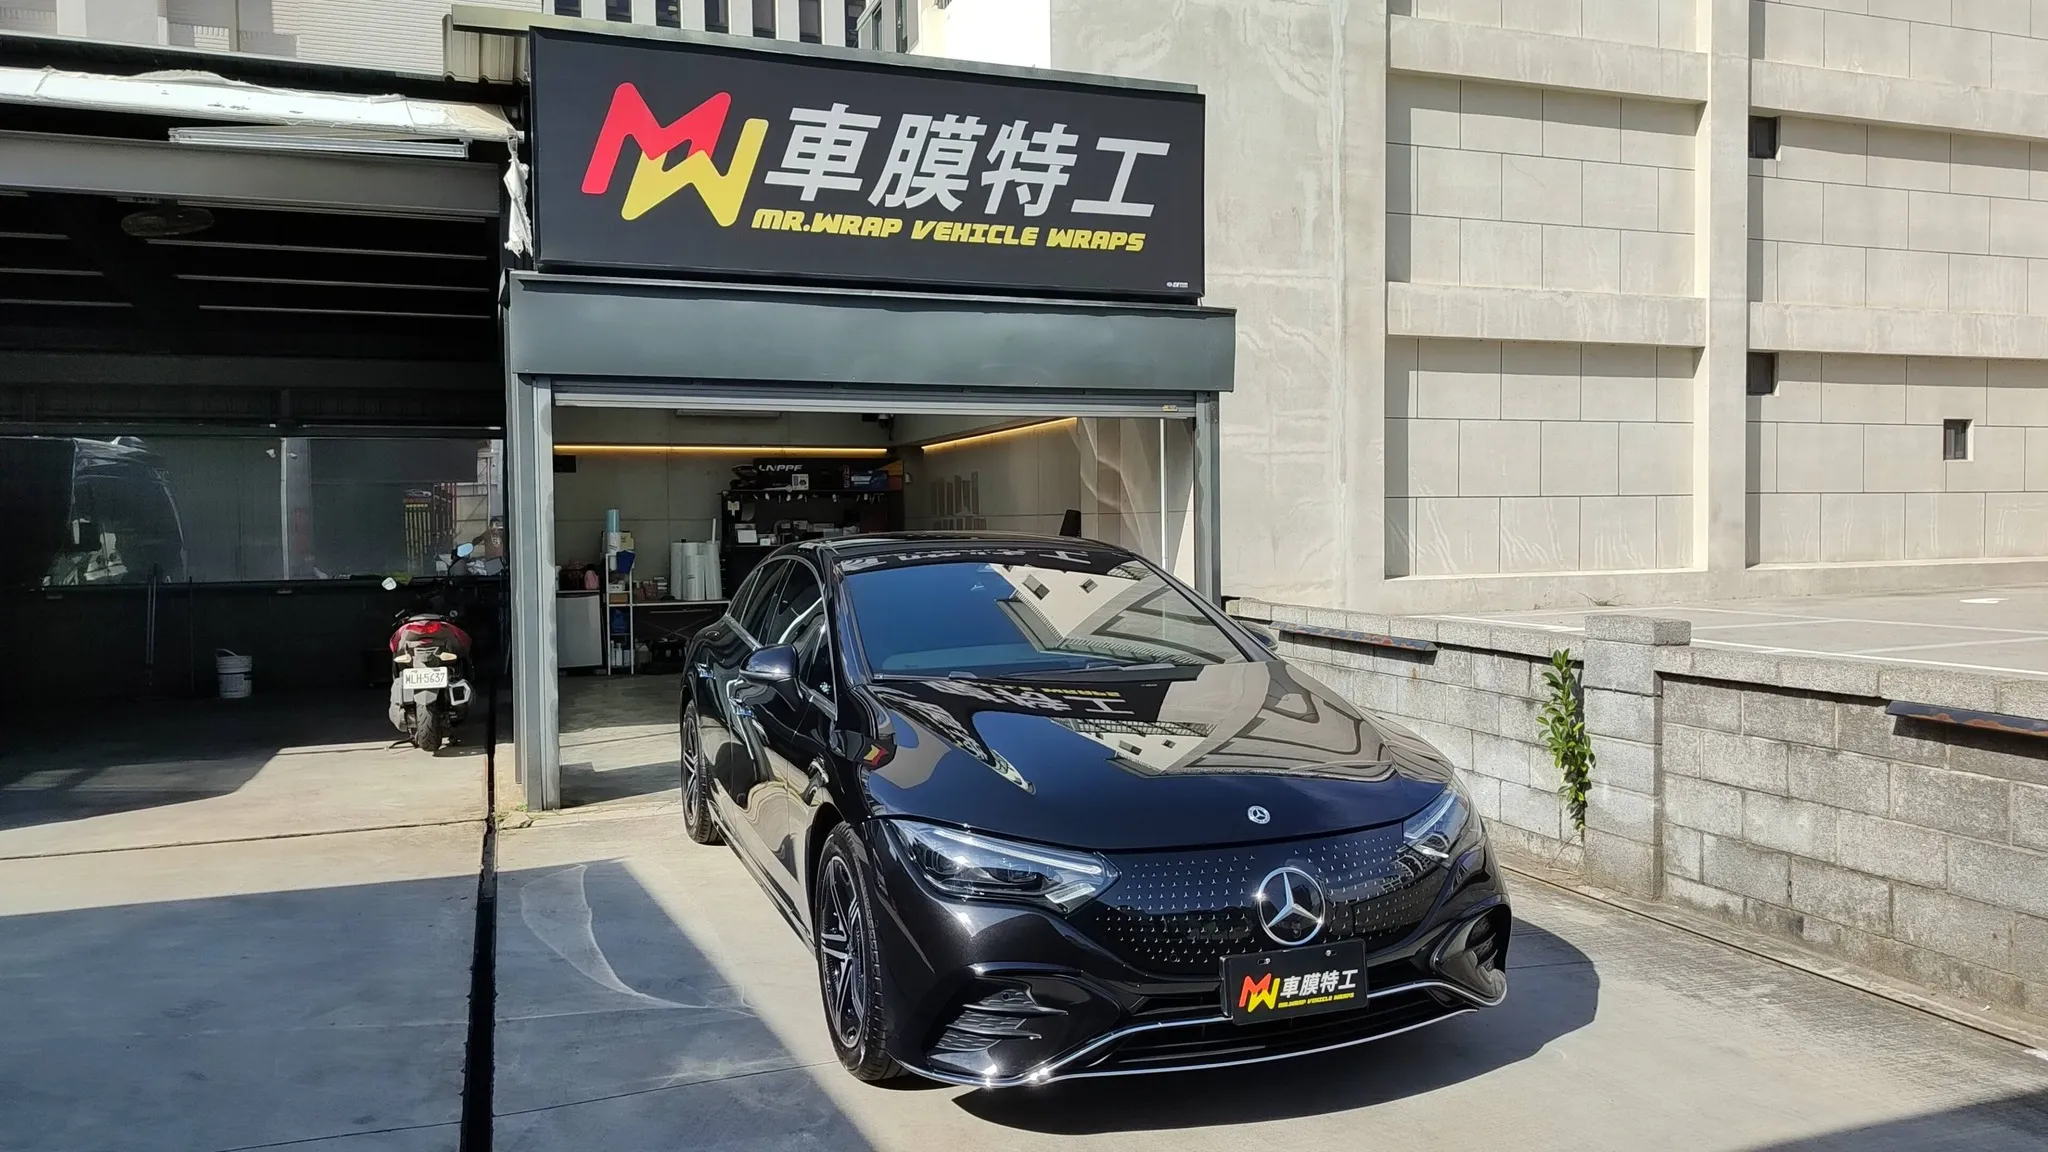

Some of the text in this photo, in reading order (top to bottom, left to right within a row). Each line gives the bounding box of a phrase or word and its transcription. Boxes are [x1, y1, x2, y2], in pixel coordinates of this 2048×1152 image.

[764, 103, 1170, 217] 車膜特工
[751, 208, 1146, 252] MR.WRAP VEHICLE WRAPS
[1280, 969, 1358, 998] 車膜特工
